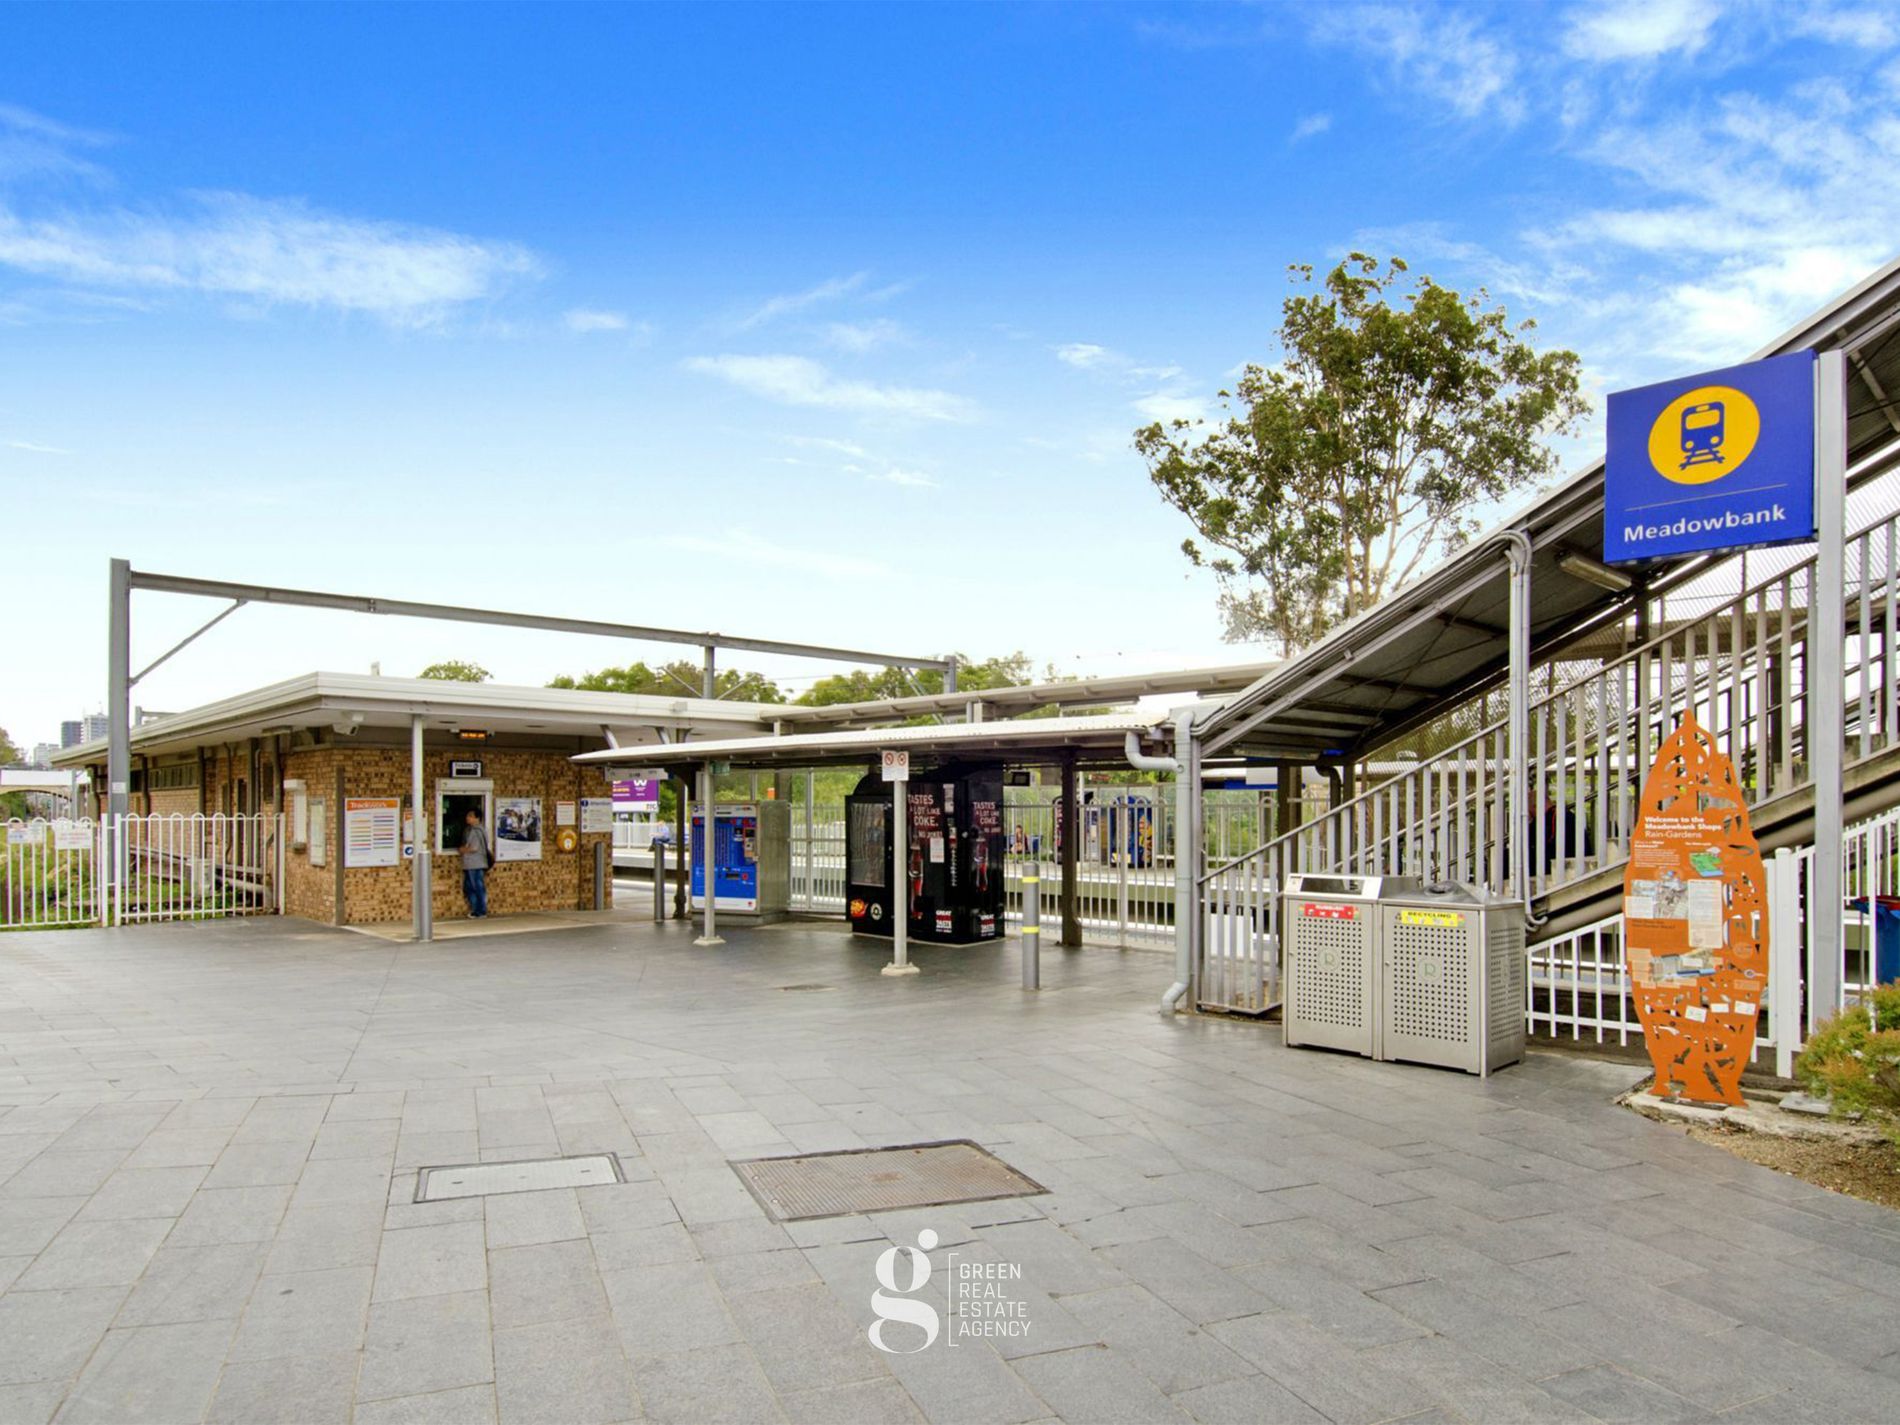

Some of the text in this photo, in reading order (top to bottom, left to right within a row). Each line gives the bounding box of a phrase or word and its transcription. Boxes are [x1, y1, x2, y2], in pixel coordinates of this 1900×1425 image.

[1624, 504, 1786, 542] Meadowbank
[907, 794, 934, 805] TASTES
[973, 801, 996, 810] TASTES
[914, 816, 939, 827] COKE.
[1645, 823, 1722, 832] Meadowbank Shops
[1645, 830, 1703, 839] Rain-Gardens
[1407, 911, 1452, 919] RECYCLING
